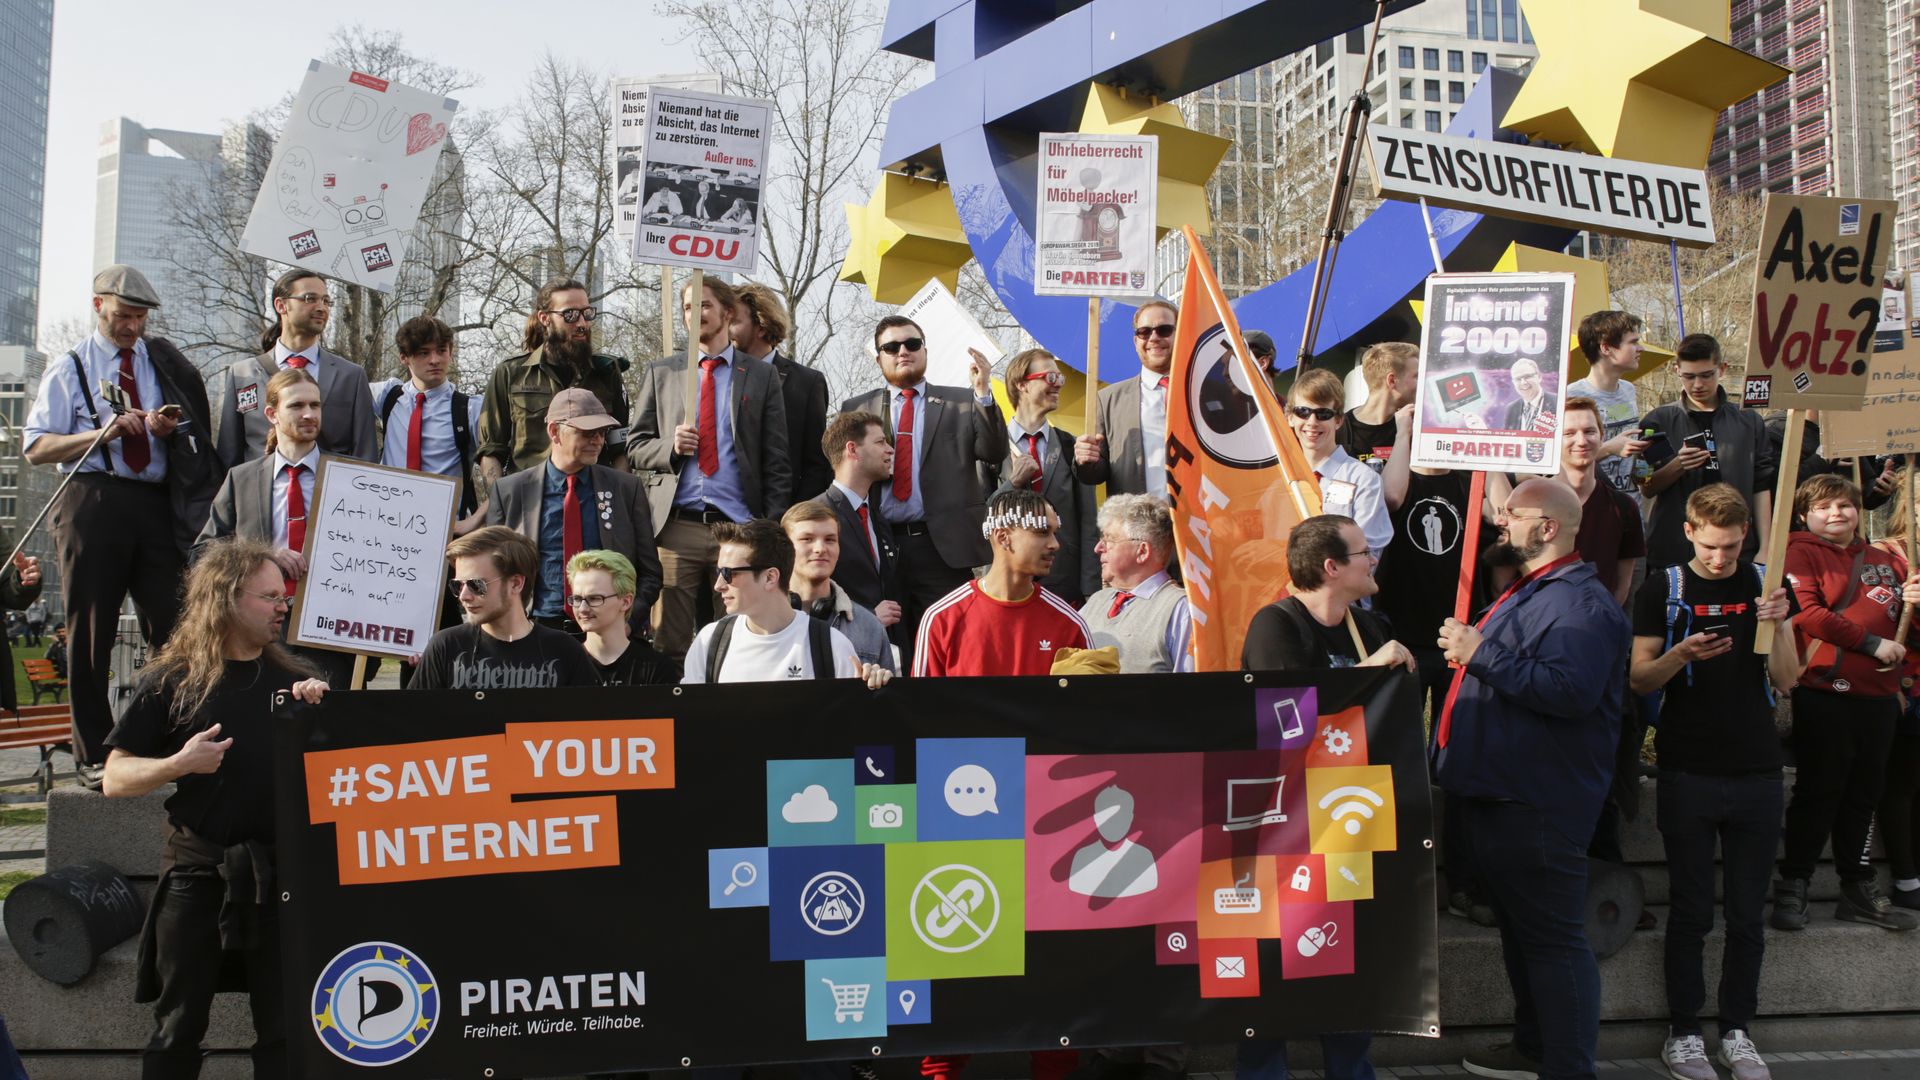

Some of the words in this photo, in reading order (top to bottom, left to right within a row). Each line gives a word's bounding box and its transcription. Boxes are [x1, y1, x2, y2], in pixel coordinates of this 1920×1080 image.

[307, 85, 412, 143] CDU
[622, 117, 633, 127] zu
[658, 101, 703, 117] Niemand
[705, 107, 721, 120] hat
[724, 110, 739, 122] die
[657, 115, 697, 131] Absicht,
[700, 120, 718, 133] das
[720, 123, 760, 139] Internet
[655, 131, 667, 141] zu
[669, 133, 719, 148] zerstören.
[704, 151, 734, 165] Außer
[736, 158, 757, 168] uns.
[1048, 142, 1143, 159] Uhrheberrecht
[280, 170, 297, 182] bin
[1047, 165, 1068, 179] für
[1377, 135, 1707, 229] ZENSURFILTER.DE
[280, 184, 299, 196] ein
[1047, 188, 1138, 205] Möbelpacker!
[291, 233, 316, 249] FCK
[646, 231, 666, 244] Ihre
[668, 234, 740, 261] CDU
[1763, 206, 1882, 287] Axel
[362, 246, 388, 261] FCK
[366, 255, 391, 267] ART.13
[1046, 270, 1060, 281] Die
[1061, 270, 1128, 286] PARTEI
[1444, 295, 1549, 322] Internet
[1439, 326, 1547, 355] 2000
[1757, 291, 1881, 377] Votz?
[238, 388, 257, 403] FCK
[1744, 392, 1769, 401] ART.13
[1745, 380, 1770, 392] FCK
[1436, 440, 1452, 451] Die
[1451, 440, 1523, 459] PARTEI
[352, 475, 414, 501] Gegen
[331, 498, 401, 528] Artikel
[404, 514, 428, 535] 13
[327, 529, 355, 544] steh
[362, 536, 382, 549] ich
[391, 543, 422, 561] sogar
[330, 552, 417, 582] SAMSTAGS
[320, 578, 355, 596] früh
[316, 616, 335, 631] Die
[334, 619, 415, 647] PARTEI
[328, 753, 491, 807] #SAVE
[522, 737, 657, 778] YOUR
[357, 814, 601, 869] INTERNET
[460, 970, 646, 1017] PIRATEN
[463, 1022, 522, 1039] Freiheit.
[526, 1018, 577, 1035] Würde.
[581, 1014, 645, 1032] Teilhabe.
